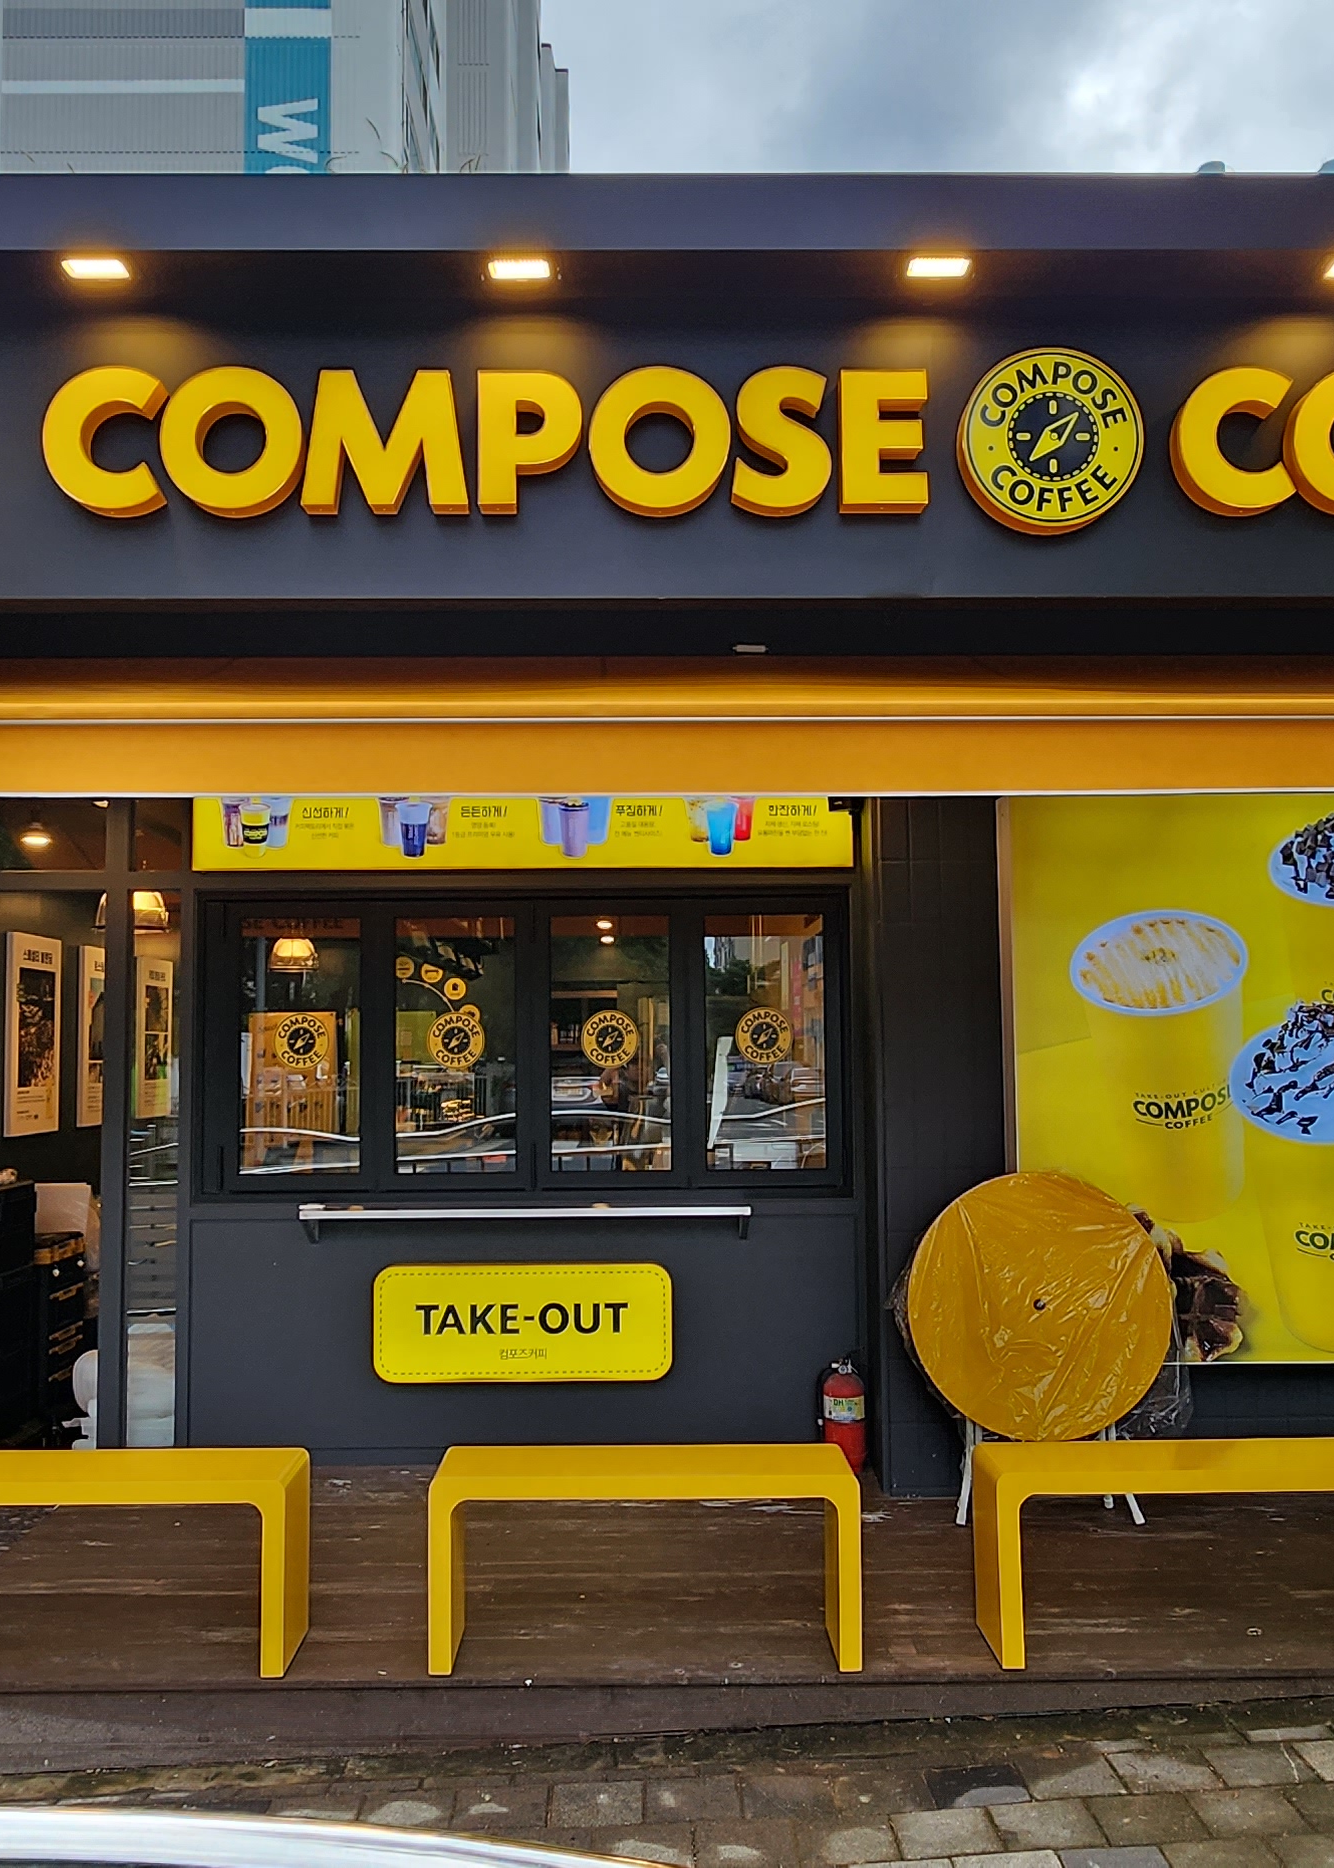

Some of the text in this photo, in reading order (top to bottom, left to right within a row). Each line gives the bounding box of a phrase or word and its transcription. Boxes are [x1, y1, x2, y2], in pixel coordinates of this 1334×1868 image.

[980, 361, 1128, 429] COMPOSE
[43, 365, 929, 517] COMPOSE
[991, 464, 1119, 513] COFFEE
[277, 1015, 326, 1040] COMPOSE
[432, 1014, 480, 1038] COMPOSE
[586, 1013, 635, 1037] COMPOSE
[740, 1011, 788, 1034] COMPOSE
[280, 1049, 322, 1066] COFFEE
[435, 1048, 477, 1065] COFFEE
[589, 1047, 631, 1065] COFFEE
[744, 1044, 786, 1061] COFFEE
[1165, 1113, 1212, 1129] COFFEE
[415, 1302, 628, 1335] TAKE-OUT
[499, 1347, 548, 1361] 컴포즈커피
